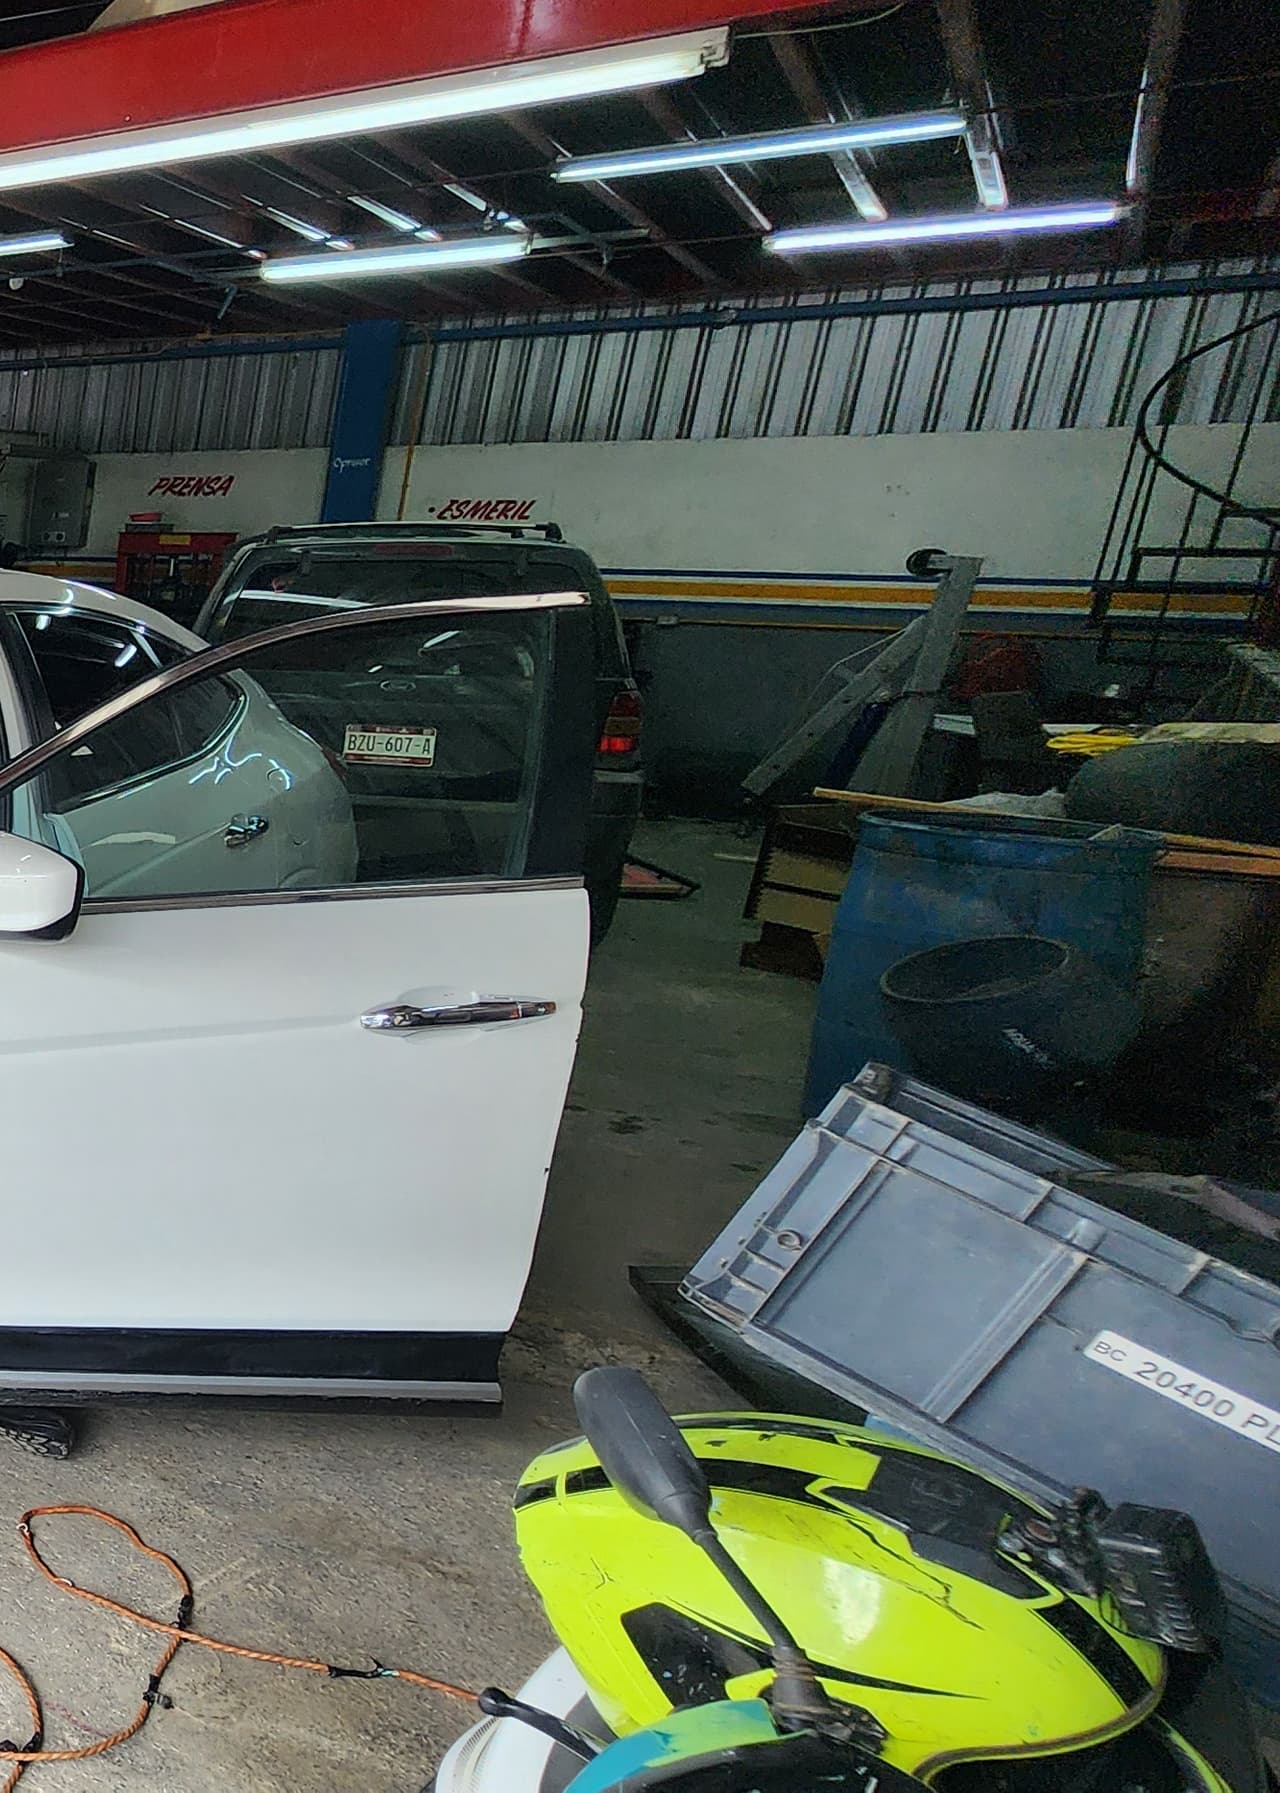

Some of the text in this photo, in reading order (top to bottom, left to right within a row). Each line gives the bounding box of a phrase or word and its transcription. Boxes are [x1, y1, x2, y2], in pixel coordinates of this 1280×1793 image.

[148, 475, 234, 496] PRENSA
[437, 499, 536, 520] ESMERIL
[347, 735, 431, 754] BZU-607-A
[1094, 1341, 1127, 1362] BC
[1133, 1361, 1236, 1418] 20400
